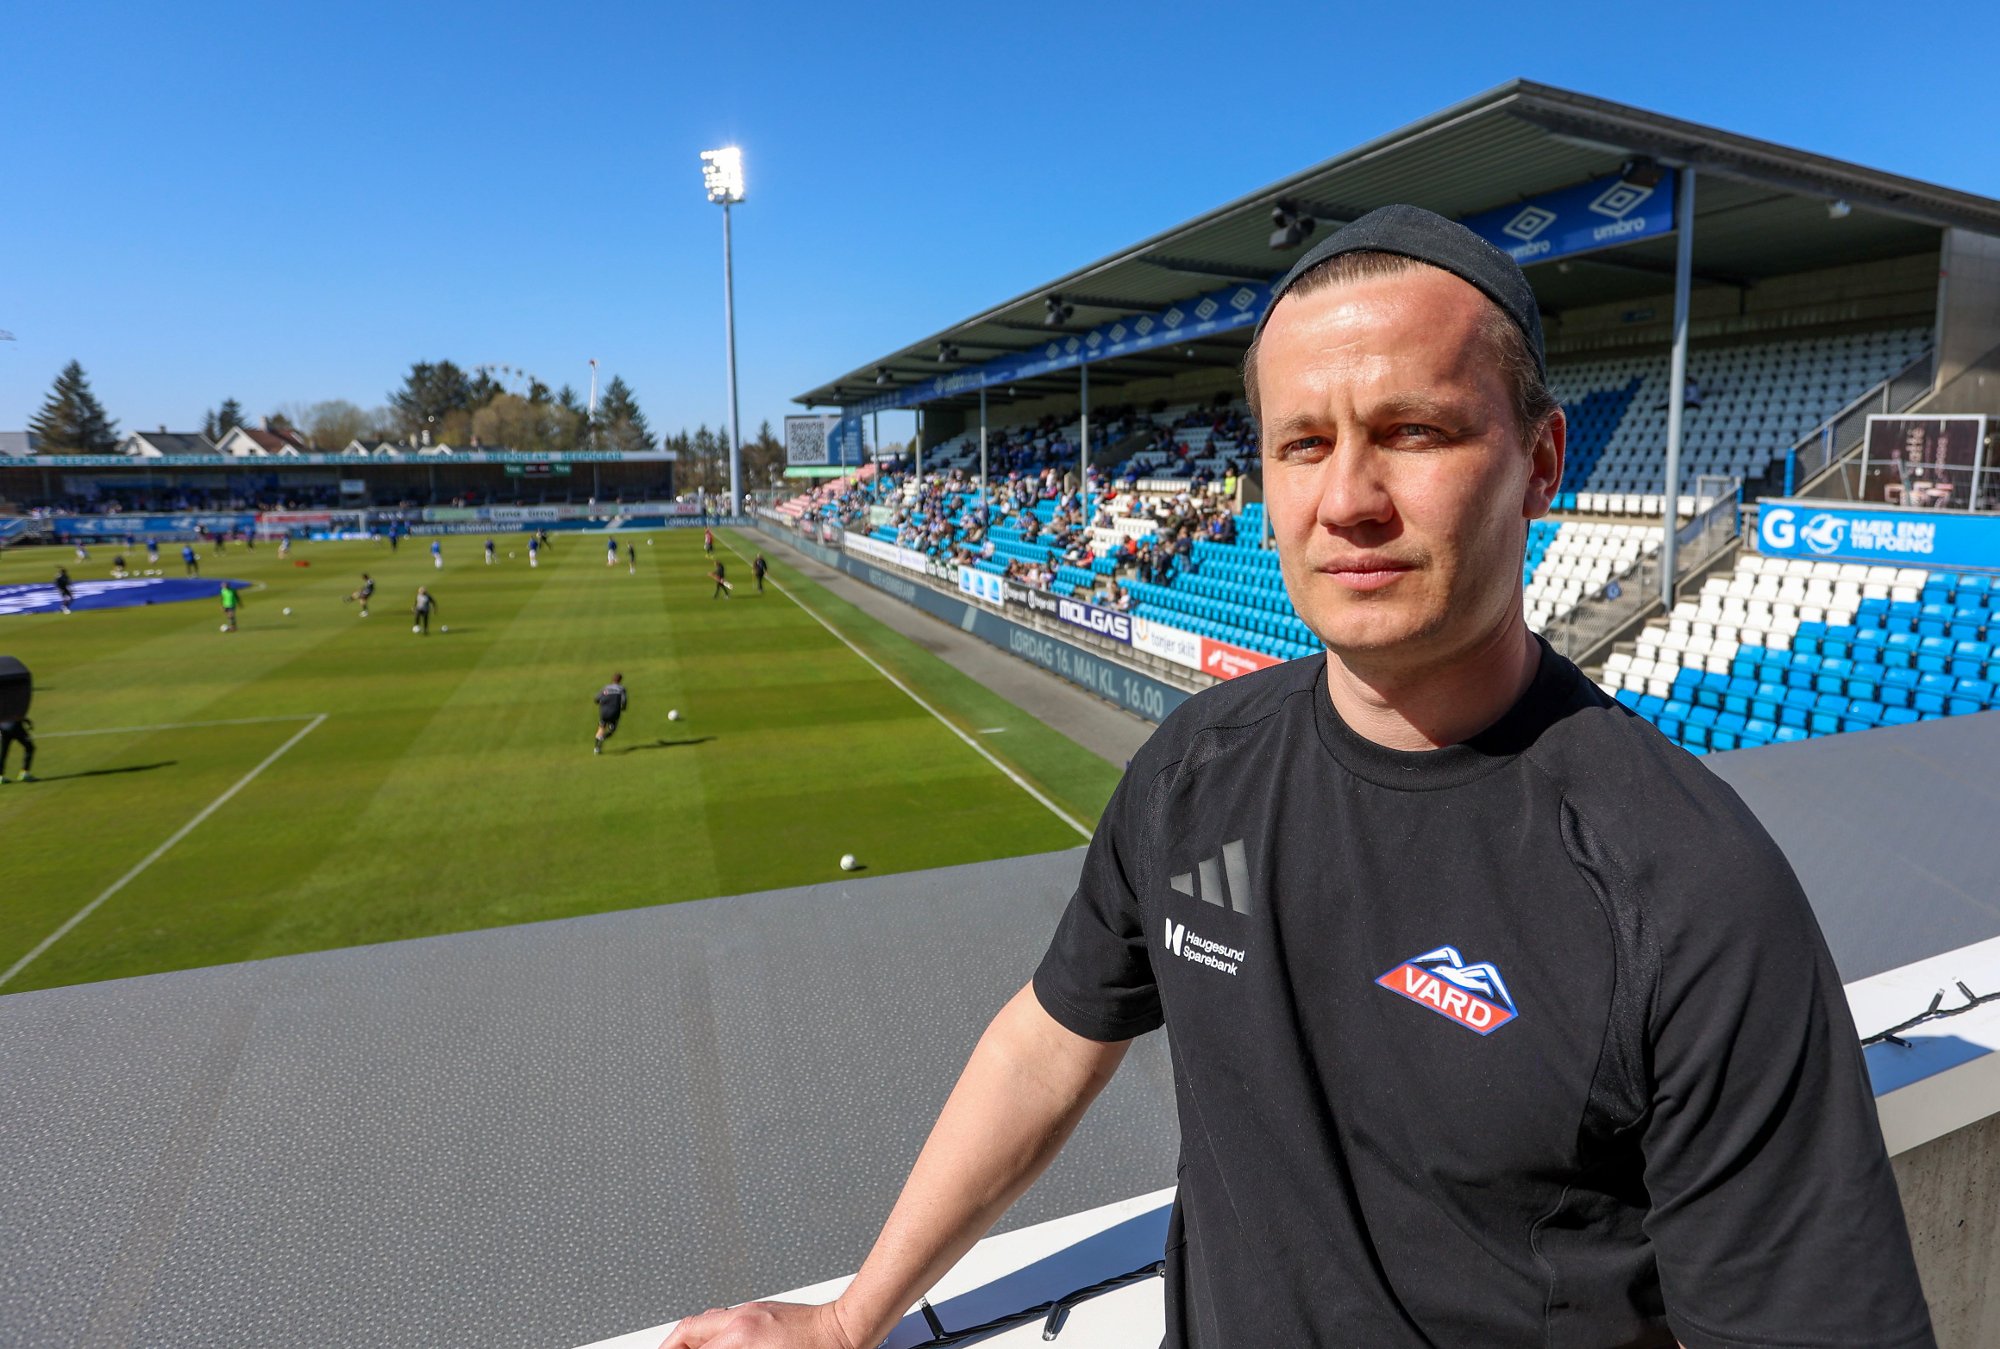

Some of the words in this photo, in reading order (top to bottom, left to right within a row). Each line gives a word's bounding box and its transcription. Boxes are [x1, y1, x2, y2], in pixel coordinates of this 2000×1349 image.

[1593, 217, 1646, 240] umbro
[1762, 508, 1796, 549] G
[1059, 599, 1129, 641] MOLGAS
[1009, 627, 1053, 667] LØRDAG
[1055, 648, 1072, 675] 16.
[1074, 655, 1097, 687] MAI
[1098, 667, 1120, 699] KL.
[1123, 677, 1164, 719] 16.00
[1183, 945, 1239, 976] Sparebank
[1185, 930, 1246, 963] Haugesund
[1405, 966, 1492, 1028] VARD
